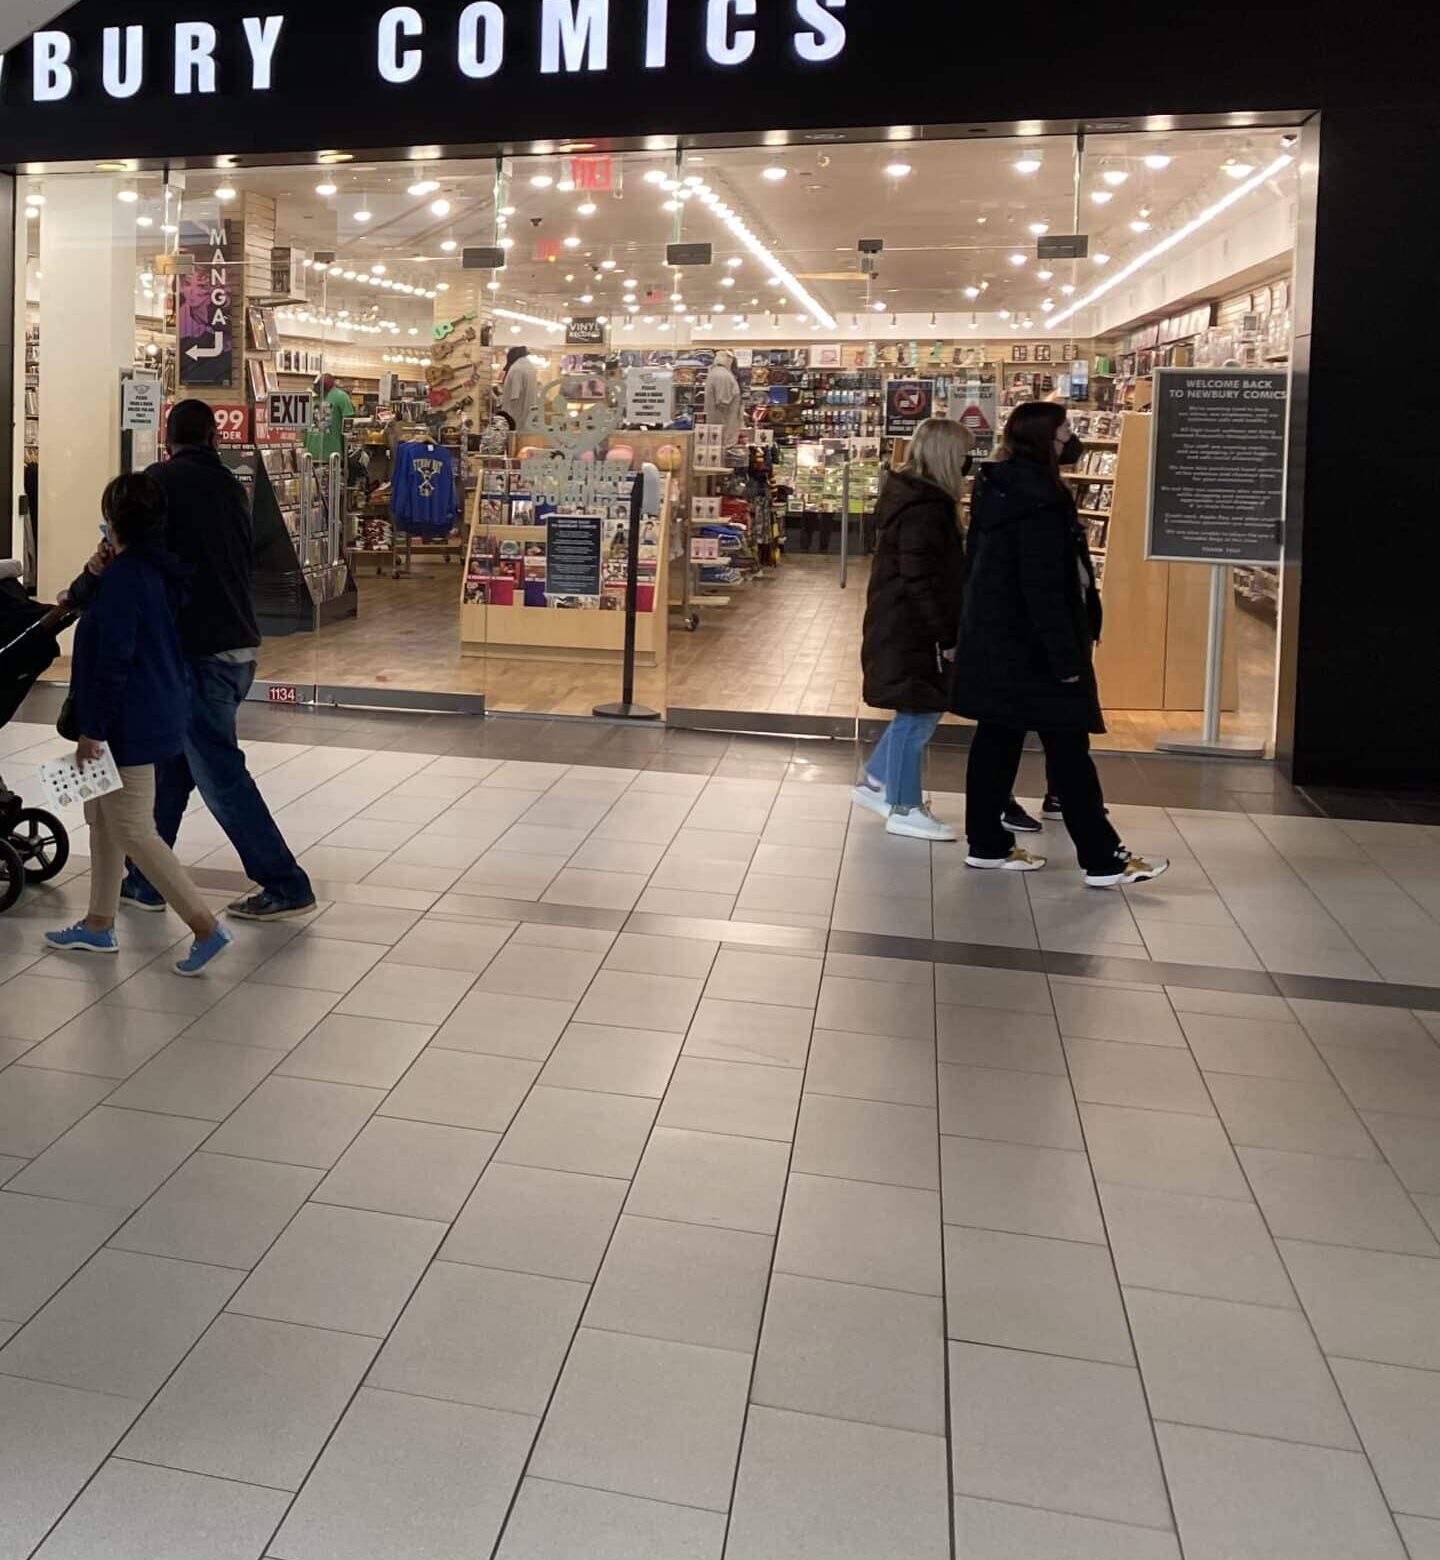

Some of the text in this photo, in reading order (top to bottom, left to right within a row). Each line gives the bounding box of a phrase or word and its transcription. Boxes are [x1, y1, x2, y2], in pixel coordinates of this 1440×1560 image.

[376, 0, 848, 82] COMICS
[210, 228, 228, 326] MANGA
[1186, 379, 1273, 389] WELCOME BACK
[1169, 389, 1184, 398] TO
[1187, 390, 1240, 399] NEWBURY
[270, 395, 310, 424] EXIT
[220, 431, 242, 440] DER
[270, 687, 295, 701] 1134
